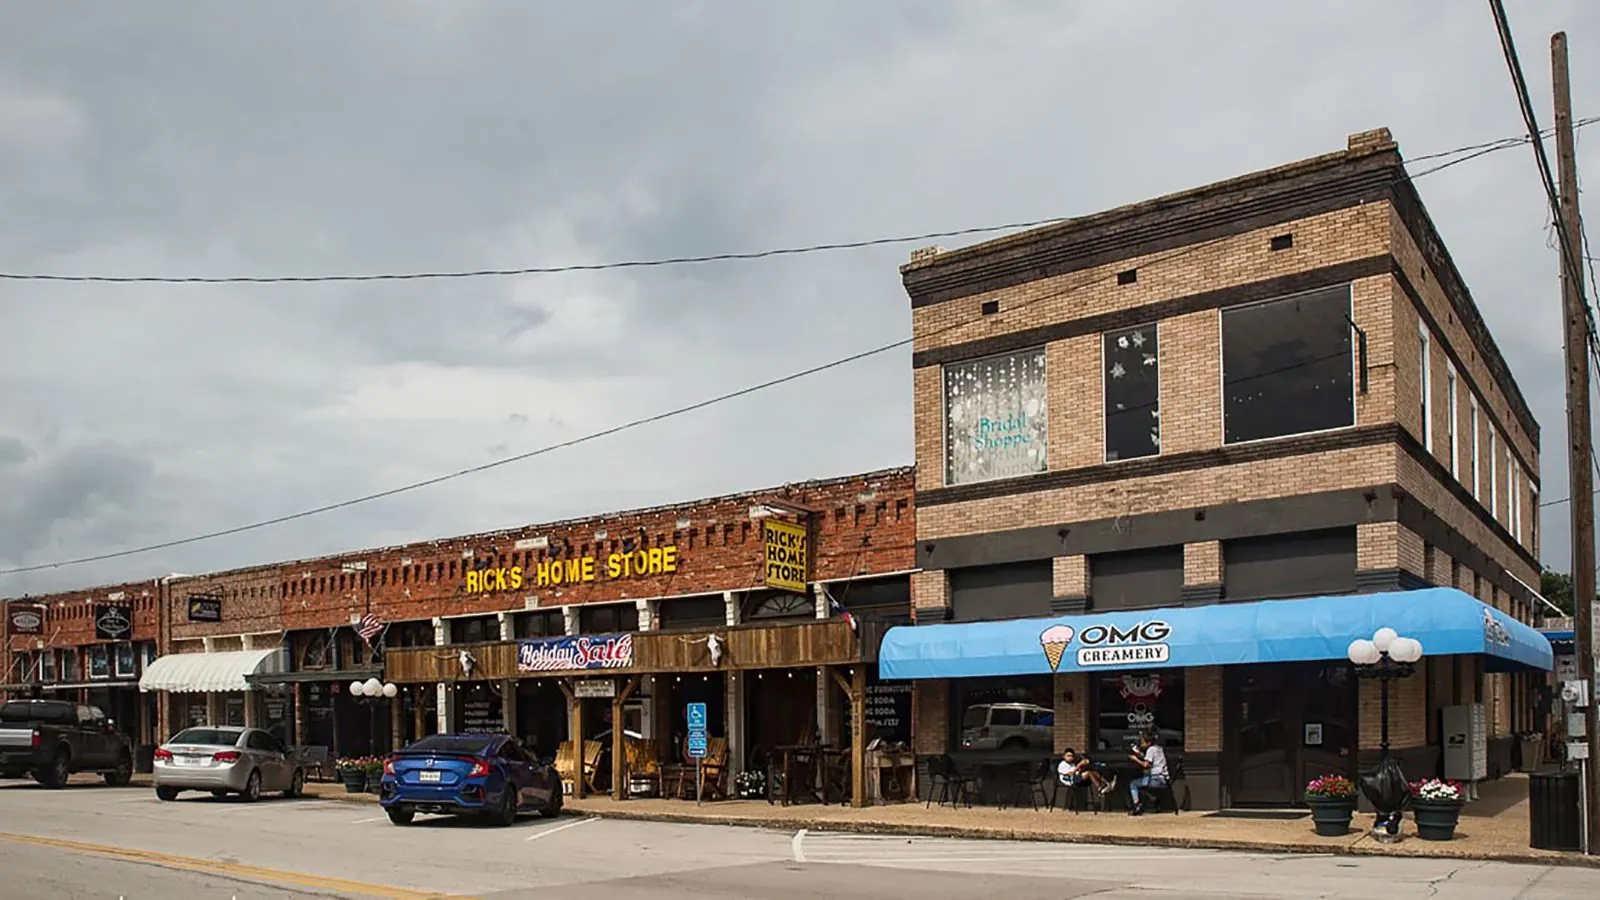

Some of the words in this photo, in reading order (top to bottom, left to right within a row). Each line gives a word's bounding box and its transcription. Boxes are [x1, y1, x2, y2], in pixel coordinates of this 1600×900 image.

[979, 410, 1027, 435] Bridal
[975, 433, 1032, 450] Shoppe
[766, 528, 806, 551] RICK'S
[537, 556, 595, 586] HOME
[608, 546, 677, 578] STORE
[767, 545, 805, 567] HOME
[767, 562, 805, 583] STORE
[1080, 622, 1170, 644] OMG
[521, 642, 575, 665] Holiday
[575, 638, 629, 667] Sale
[1083, 647, 1163, 662] CREAMERY
[1127, 712, 1154, 723] OMG
